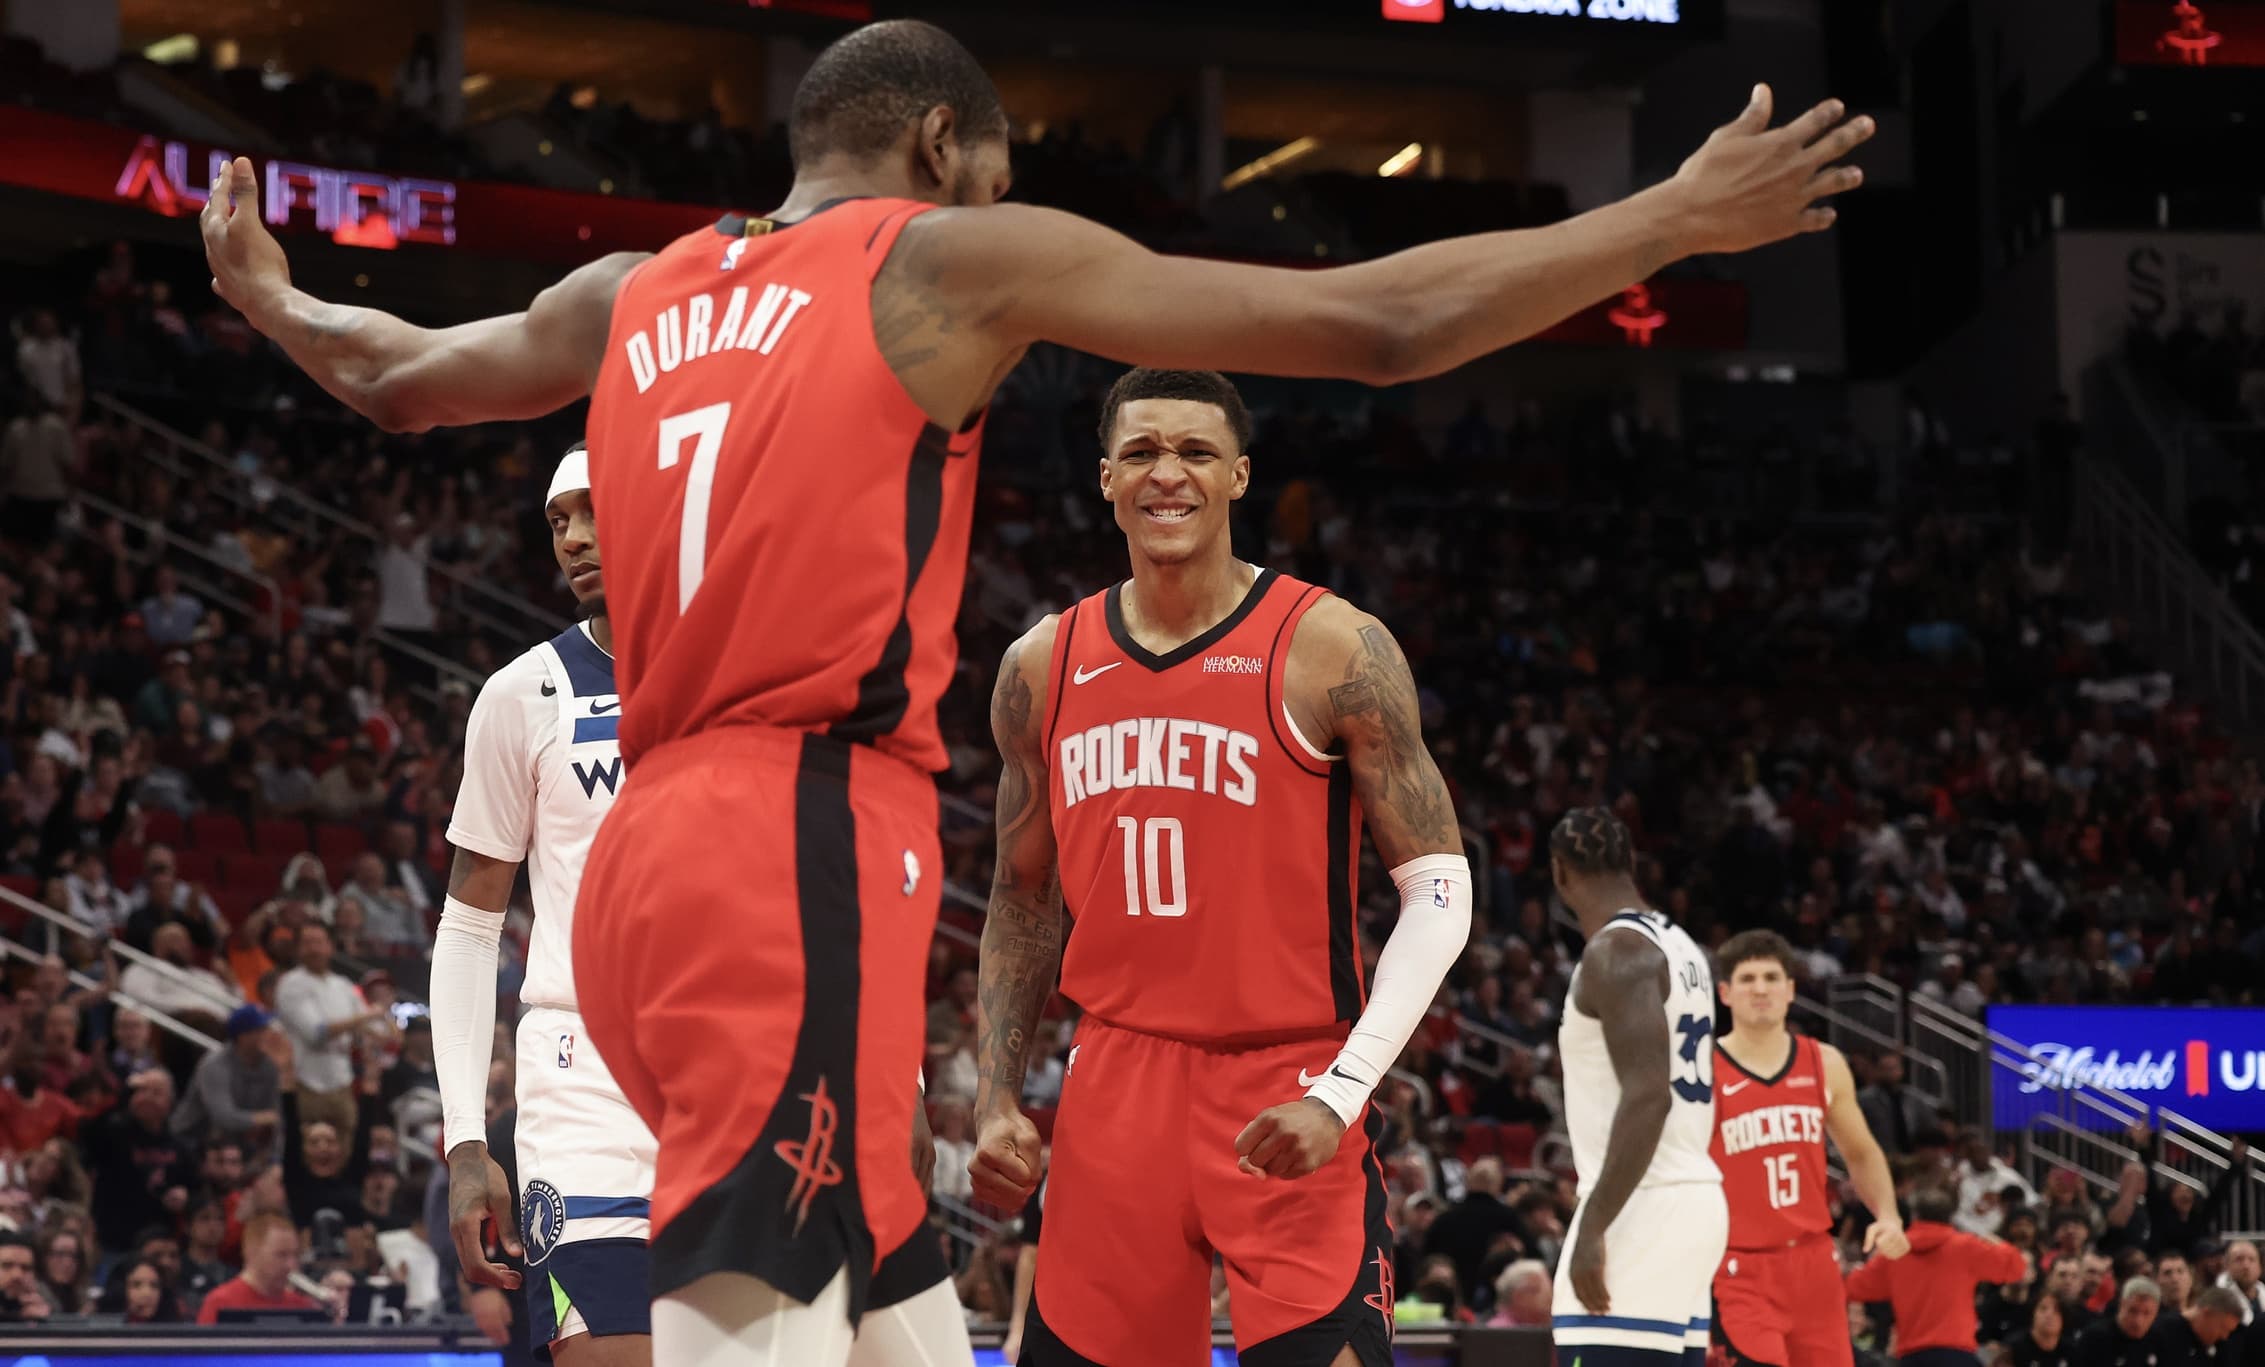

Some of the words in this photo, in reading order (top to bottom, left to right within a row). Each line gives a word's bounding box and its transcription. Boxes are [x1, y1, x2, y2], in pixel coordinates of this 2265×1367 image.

[625, 283, 812, 394] DURANT
[658, 401, 732, 616] 7
[1203, 663, 1263, 674] HERMANN
[1204, 655, 1263, 667] MEMORIAL
[1060, 717, 1259, 809] ROCKETS
[1116, 815, 1188, 917] 10
[1721, 1104, 1824, 1156] ROCKETS
[530, 1181, 562, 1242] TIMBERWOLVES
[1763, 1153, 1799, 1209] 15
